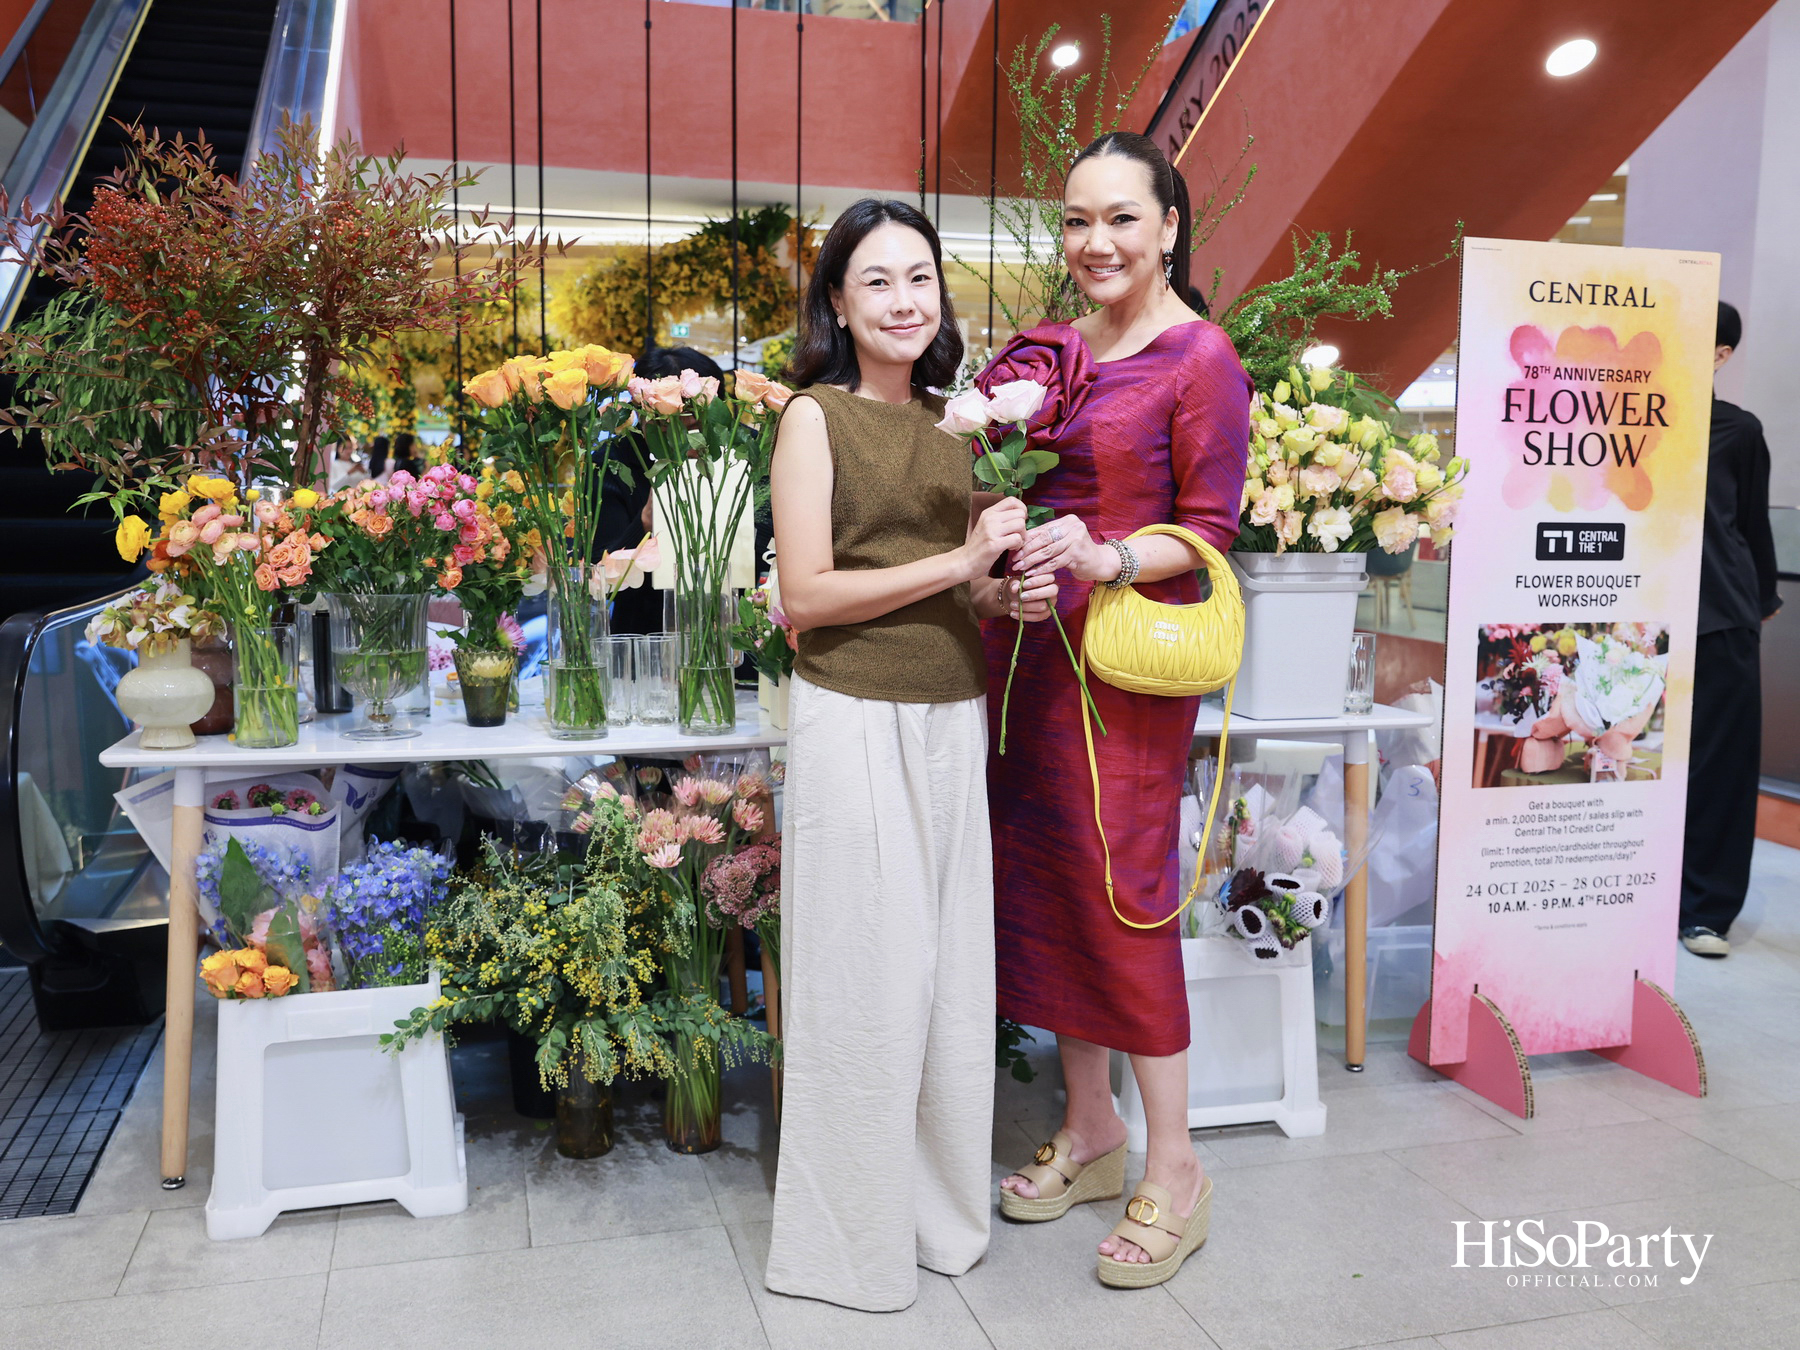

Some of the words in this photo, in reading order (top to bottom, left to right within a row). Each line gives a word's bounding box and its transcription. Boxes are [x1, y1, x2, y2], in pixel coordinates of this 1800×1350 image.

[1529, 280, 1656, 309] CENTRAL
[1524, 365, 1550, 379] 78TH
[1553, 367, 1652, 384] ANNIVERSARY
[1501, 388, 1669, 427] FLOWER
[1523, 430, 1647, 468] SHOW
[1543, 530, 1574, 553] T1
[1579, 530, 1619, 542] CENTRAL
[1578, 542, 1596, 553] THE
[1597, 542, 1603, 553] 1
[1515, 575, 1573, 588] FLOWER
[1576, 575, 1641, 590] BOUQUET
[1538, 594, 1618, 607] WORKSHOP
[1407, 777, 1423, 797] 3
[1528, 801, 1543, 811] Get
[1552, 800, 1585, 811] bouquet
[1587, 798, 1604, 807] with
[1492, 815, 1510, 825] min.
[1512, 814, 1536, 826] 2,000
[1538, 812, 1557, 823] Baht
[1558, 812, 1581, 823] spent
[1589, 811, 1609, 820] sales
[1611, 810, 1625, 821] slip
[1626, 809, 1643, 818] with
[1515, 826, 1545, 837] Central
[1547, 826, 1562, 836] The
[1569, 823, 1594, 834] Credit
[1595, 823, 1615, 833] Card
[1481, 847, 1505, 857] (limit:
[1511, 842, 1601, 856] redemption/cardholder
[1602, 839, 1644, 851] throughout
[1489, 858, 1533, 869] promotion,
[1534, 856, 1553, 865] total
[1554, 855, 1564, 864] 70
[1466, 884, 1482, 897] 24
[1488, 882, 1518, 896] OCT
[1523, 879, 1555, 894] 2025
[1572, 877, 1587, 890] 28
[1592, 875, 1622, 888] OCT
[1626, 872, 1656, 886] 2025
[1488, 902, 1500, 914] 10
[1503, 901, 1530, 913] A.M.
[1542, 899, 1548, 910] 9
[1551, 898, 1575, 909] P.M.
[1577, 895, 1594, 907] 4TH
[1596, 893, 1634, 906] FLOOR
